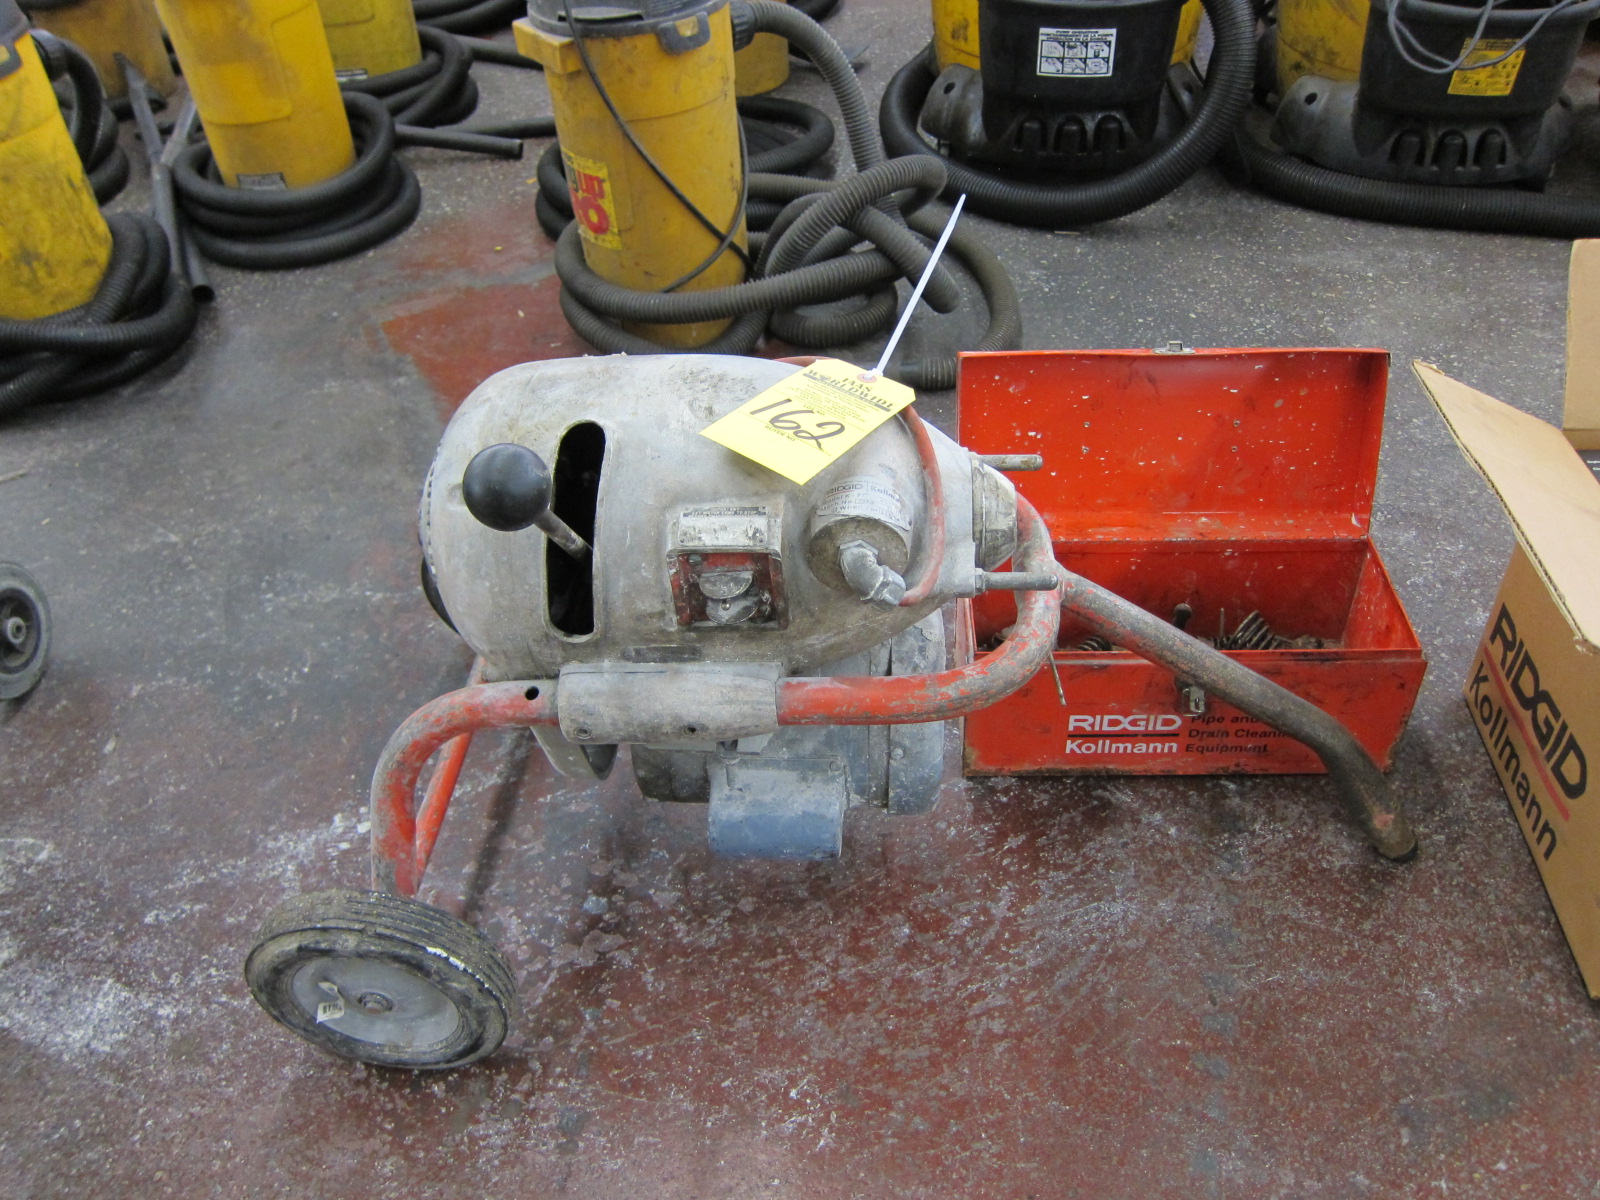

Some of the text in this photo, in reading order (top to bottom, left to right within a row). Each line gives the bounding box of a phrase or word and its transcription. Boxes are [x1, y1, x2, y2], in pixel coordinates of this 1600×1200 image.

[749, 398, 845, 451] 162
[826, 483, 864, 496] RIDGID
[1489, 602, 1587, 799] RIDGID
[1068, 714, 1182, 731] RIDGID
[1191, 715, 1225, 725] Pipe
[1188, 729, 1230, 738] Drain
[1065, 739, 1178, 754] Kollmann
[1185, 743, 1269, 754] Equipment
[1469, 661, 1557, 861] Kollmann
